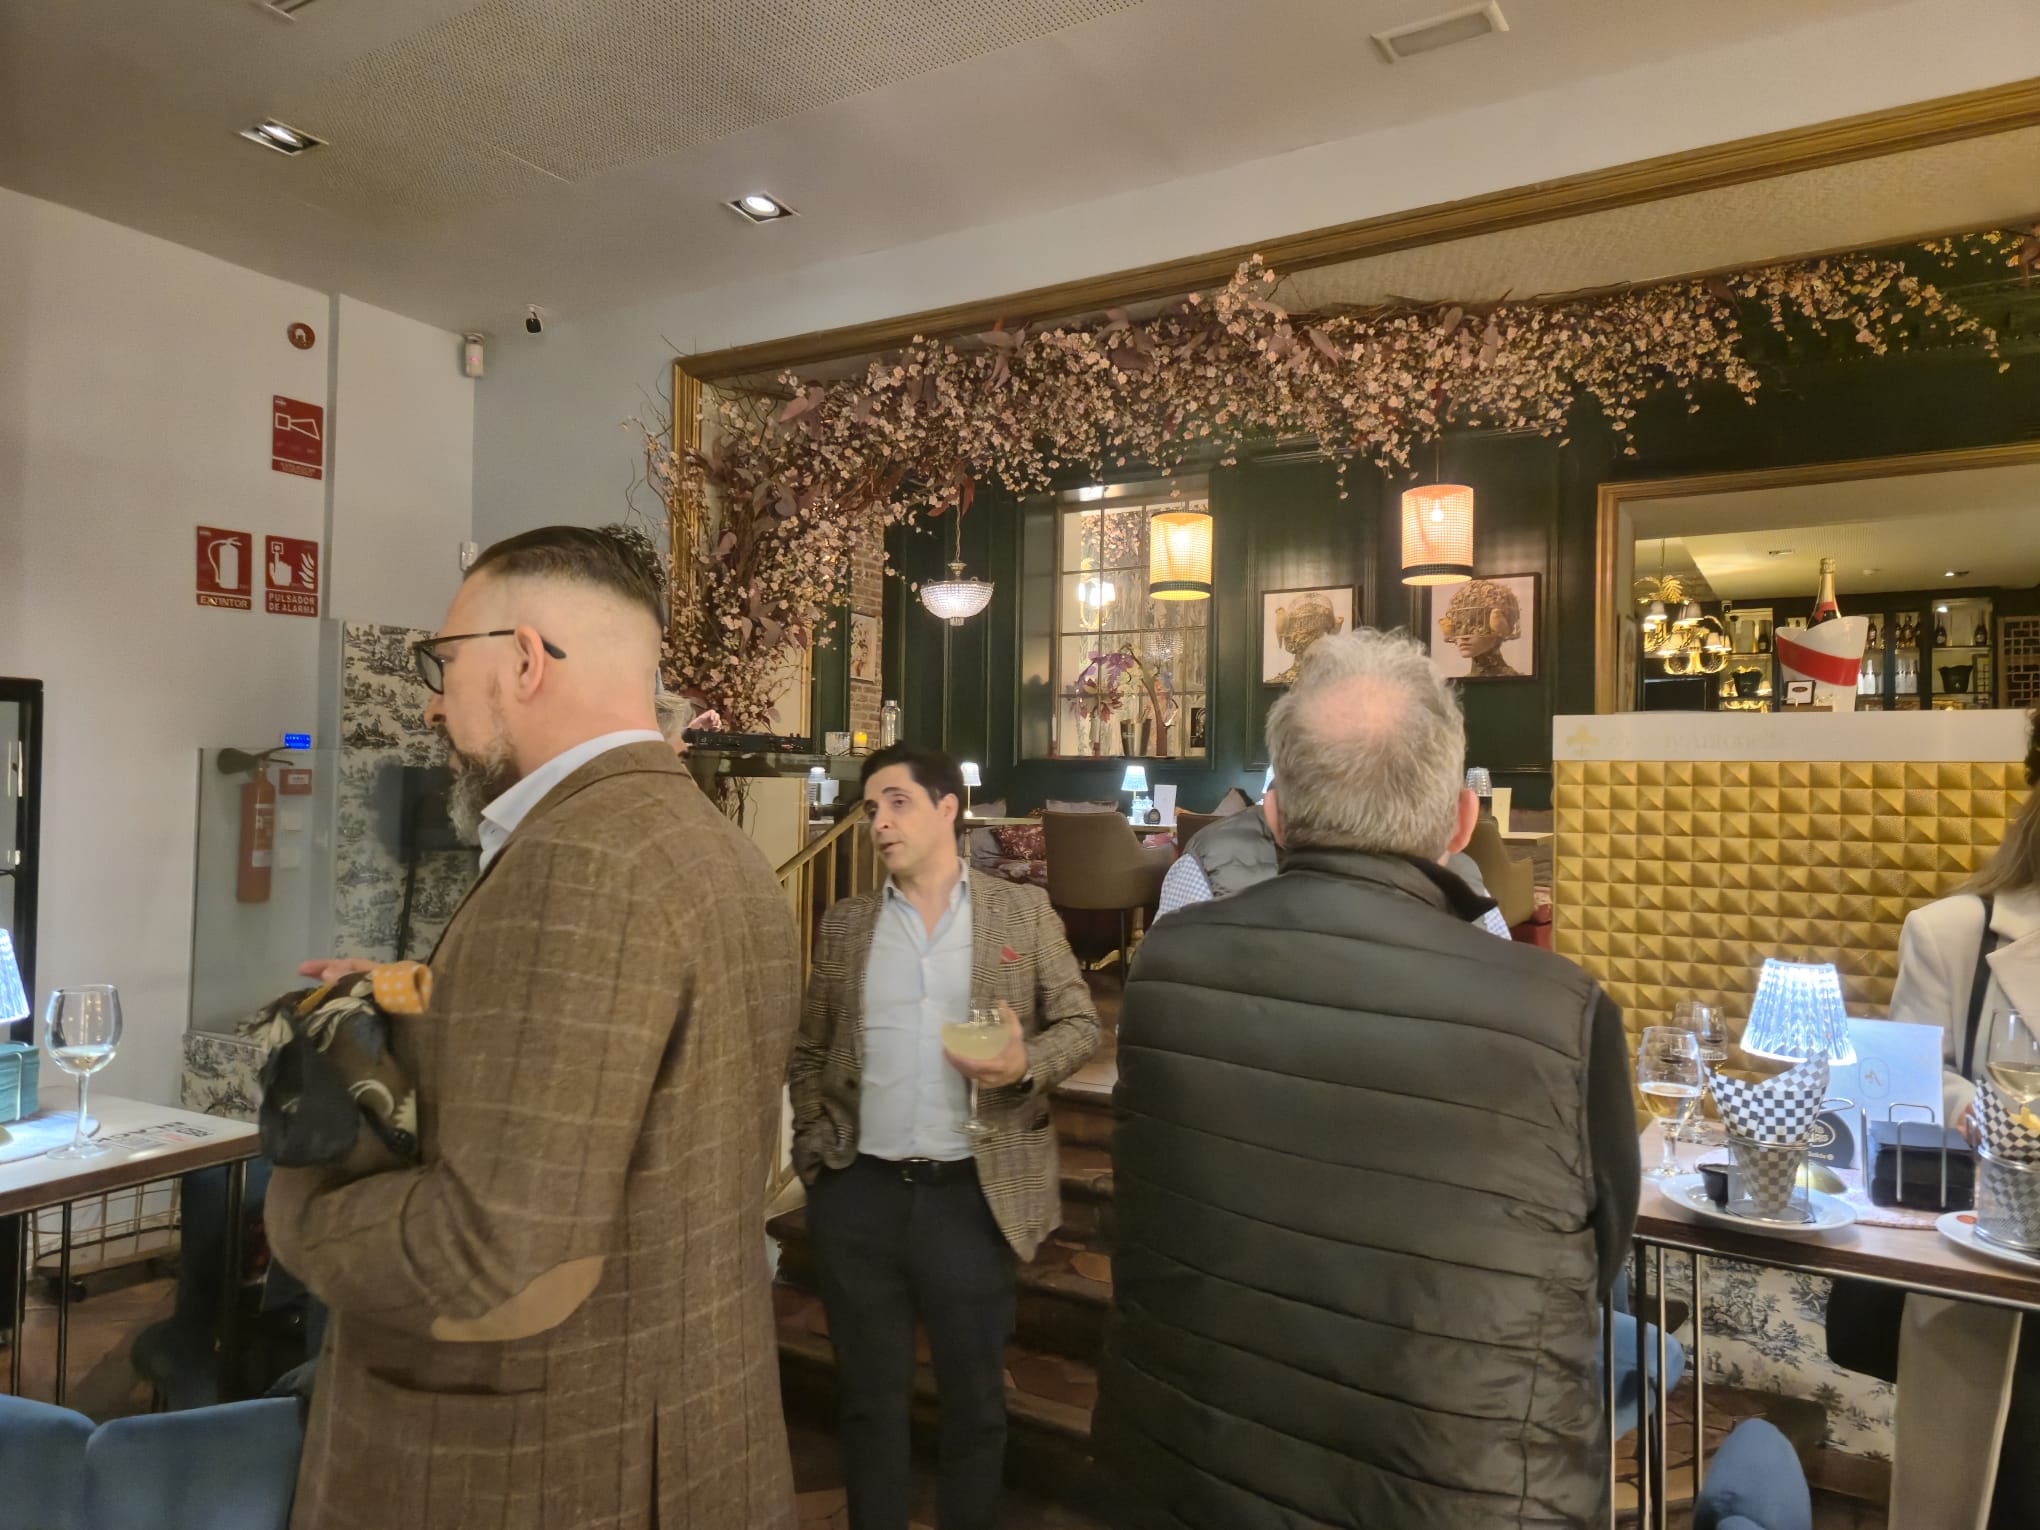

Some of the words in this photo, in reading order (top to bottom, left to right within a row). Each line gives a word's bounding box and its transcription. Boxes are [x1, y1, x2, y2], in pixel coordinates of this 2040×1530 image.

[199, 596, 247, 607] EXTINTOR
[268, 593, 315, 605] PULSADOR
[268, 603, 281, 611] DE
[282, 604, 315, 614] ALARMA
